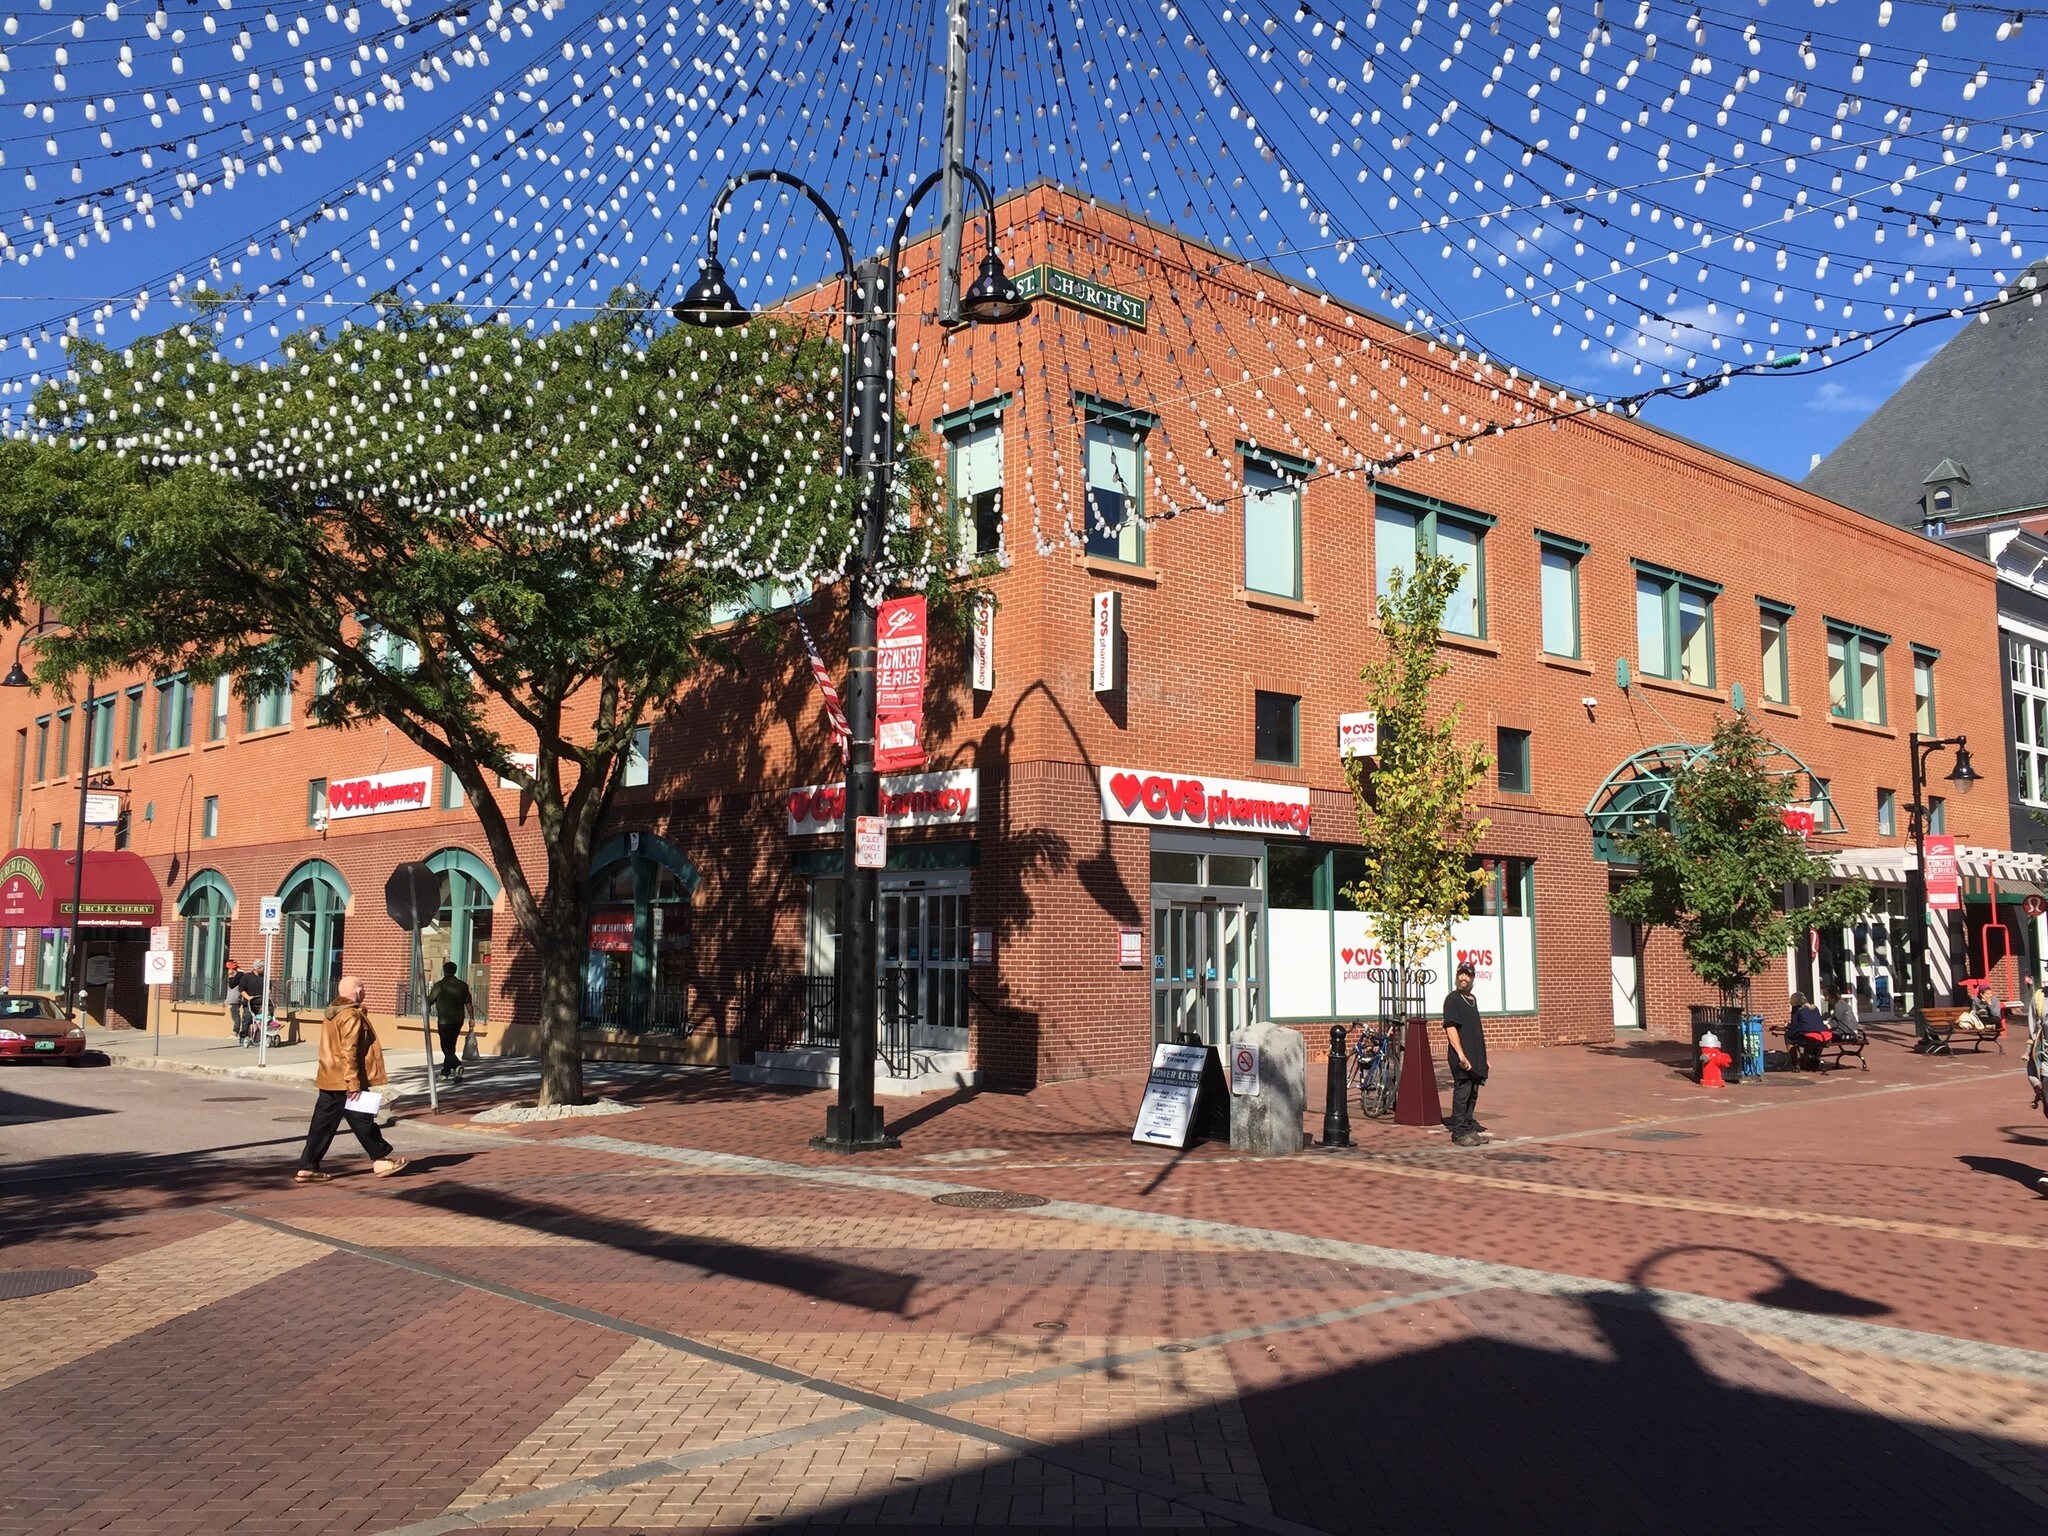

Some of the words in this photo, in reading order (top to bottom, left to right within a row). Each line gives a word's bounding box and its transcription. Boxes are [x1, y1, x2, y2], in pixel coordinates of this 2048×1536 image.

[1053, 274, 1118, 312] CHURCH
[1122, 299, 1141, 320] ST.
[980, 610, 989, 637] CVS
[877, 647, 922, 670] CONCERT
[977, 637, 986, 687] pharmacy
[1098, 638, 1107, 687] pharmacy
[877, 669, 920, 686] SERIES
[1353, 723, 1375, 735] CVS
[1344, 736, 1374, 746] pharmacy
[341, 780, 371, 808] CVS
[370, 782, 426, 809] pharmacy
[811, 788, 846, 822] CV
[879, 786, 971, 817] harmacy
[1141, 776, 1206, 816] CVS
[1207, 790, 1311, 831] pharmacy
[862, 835, 880, 843] POLICE
[860, 844, 881, 852] VEHICLE
[1928, 859, 1954, 868] CONCERT
[592, 924, 608, 933] NOW
[609, 923, 634, 933] HIRING
[1355, 947, 1383, 966] CVS
[1469, 949, 1493, 966] CVS
[1152, 1068, 1177, 1079] LOWER
[1178, 1071, 1199, 1082] LEVEL
[1152, 1088, 1170, 1096] Monday
